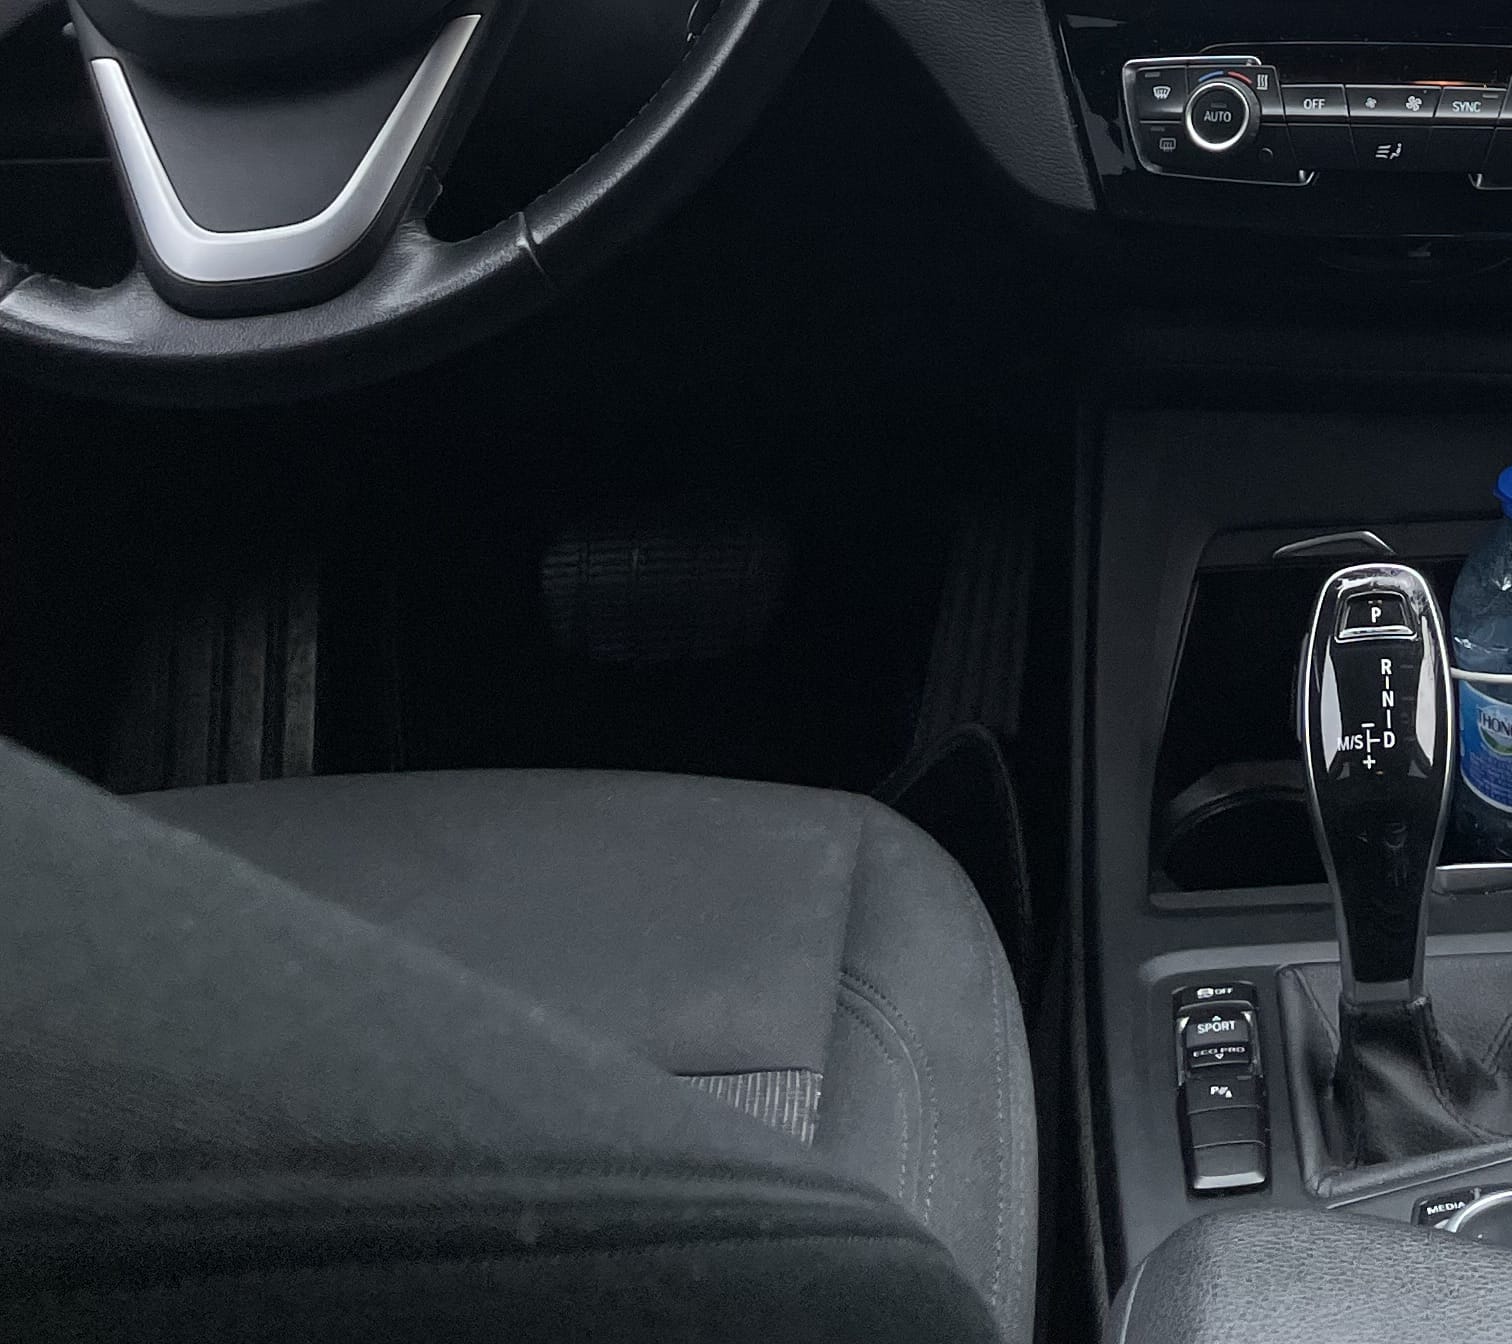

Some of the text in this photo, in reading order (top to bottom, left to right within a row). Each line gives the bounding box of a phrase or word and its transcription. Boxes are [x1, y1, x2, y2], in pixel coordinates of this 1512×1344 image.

[1303, 98, 1326, 110] OFF
[1452, 100, 1481, 113] SYNC
[1203, 110, 1232, 123] AUTO
[1371, 606, 1382, 624] P
[1380, 658, 1392, 675] R
[1382, 690, 1395, 708] N
[1336, 734, 1364, 752] M/S
[1383, 730, 1396, 749] D
[1197, 1020, 1237, 1035] SPORT
[1193, 1046, 1246, 1058] ECO PRO
[1426, 1201, 1467, 1216] MEDIA
